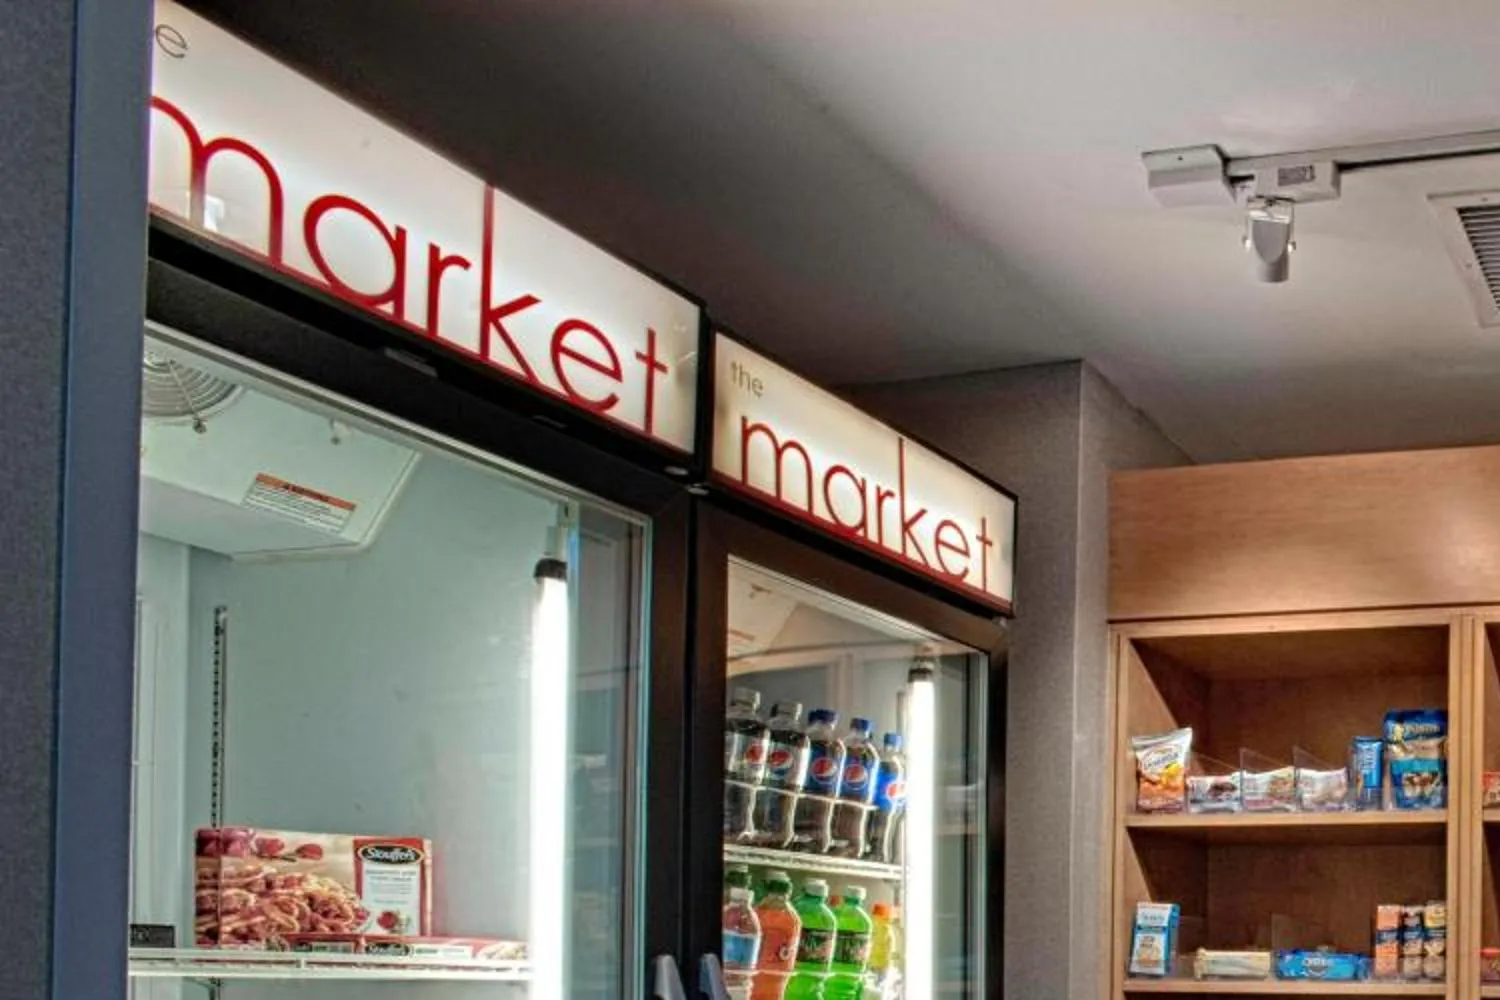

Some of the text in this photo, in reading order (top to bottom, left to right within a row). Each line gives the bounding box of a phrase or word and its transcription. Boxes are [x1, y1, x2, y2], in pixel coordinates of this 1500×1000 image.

[149, 96, 668, 437] market
[729, 359, 765, 400] the
[740, 415, 994, 592] market
